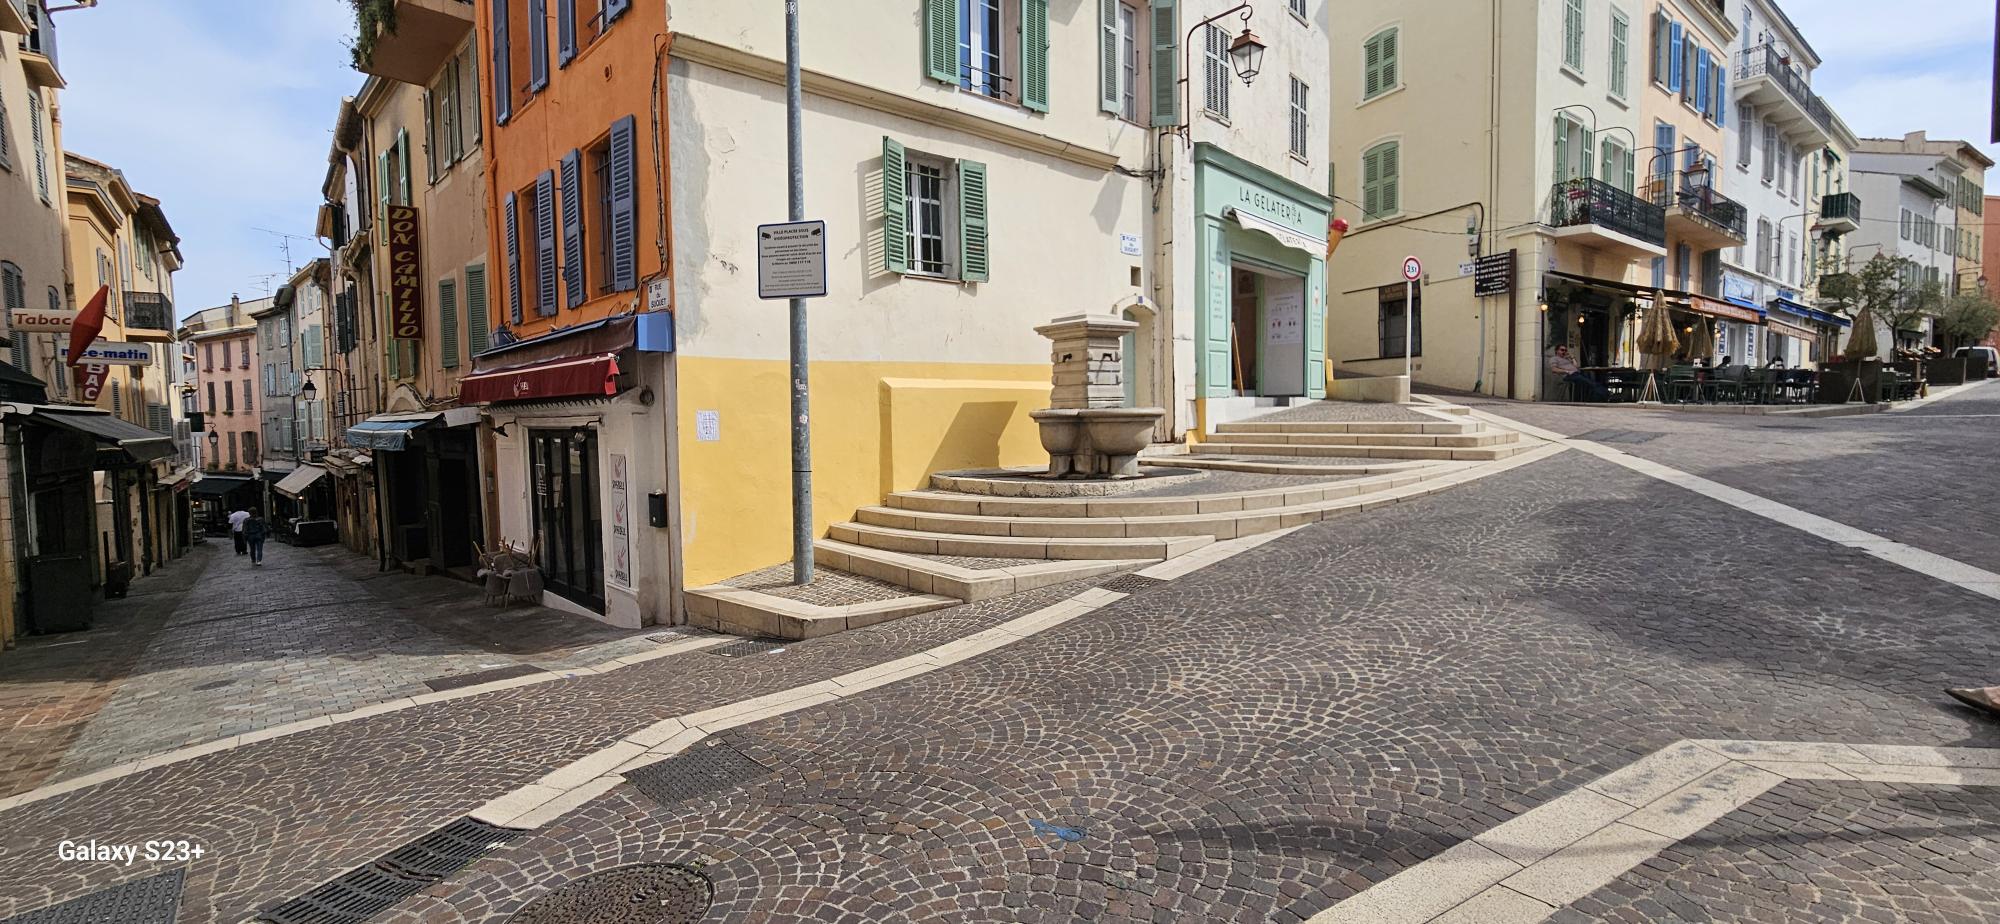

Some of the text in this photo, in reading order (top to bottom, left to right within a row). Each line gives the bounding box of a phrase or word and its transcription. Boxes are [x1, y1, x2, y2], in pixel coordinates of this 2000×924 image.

[1239, 186, 1251, 205] LA
[391, 208, 419, 337] DON CAMILLO
[651, 298, 666, 308] SUQUET
[14, 313, 71, 325] Tabac
[61, 348, 148, 359] ne-matin
